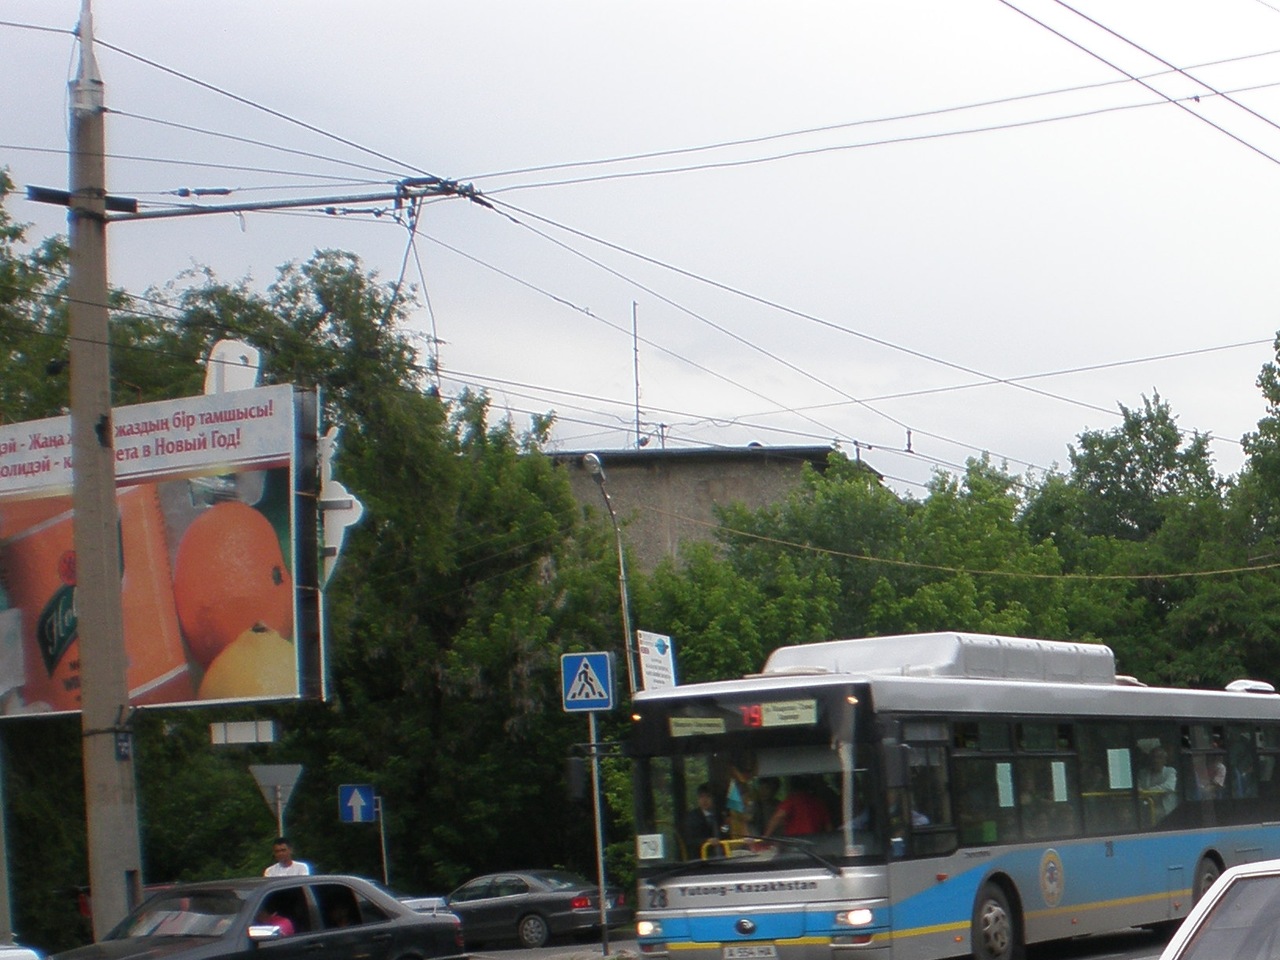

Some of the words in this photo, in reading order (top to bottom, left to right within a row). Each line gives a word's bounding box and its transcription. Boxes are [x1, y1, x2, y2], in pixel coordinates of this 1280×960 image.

[29, 433, 65, 450] Жаңа
[115, 418, 169, 438] жаздың
[172, 411, 195, 431] бір
[199, 400, 273, 425] тамшысы!
[0, 455, 51, 478] олидэй
[142, 444, 151, 457] в
[154, 432, 207, 456] Новый
[211, 428, 241, 449] Год!
[648, 888, 668, 908] 28
[679, 880, 818, 897] Yutong-Kazakhstan
